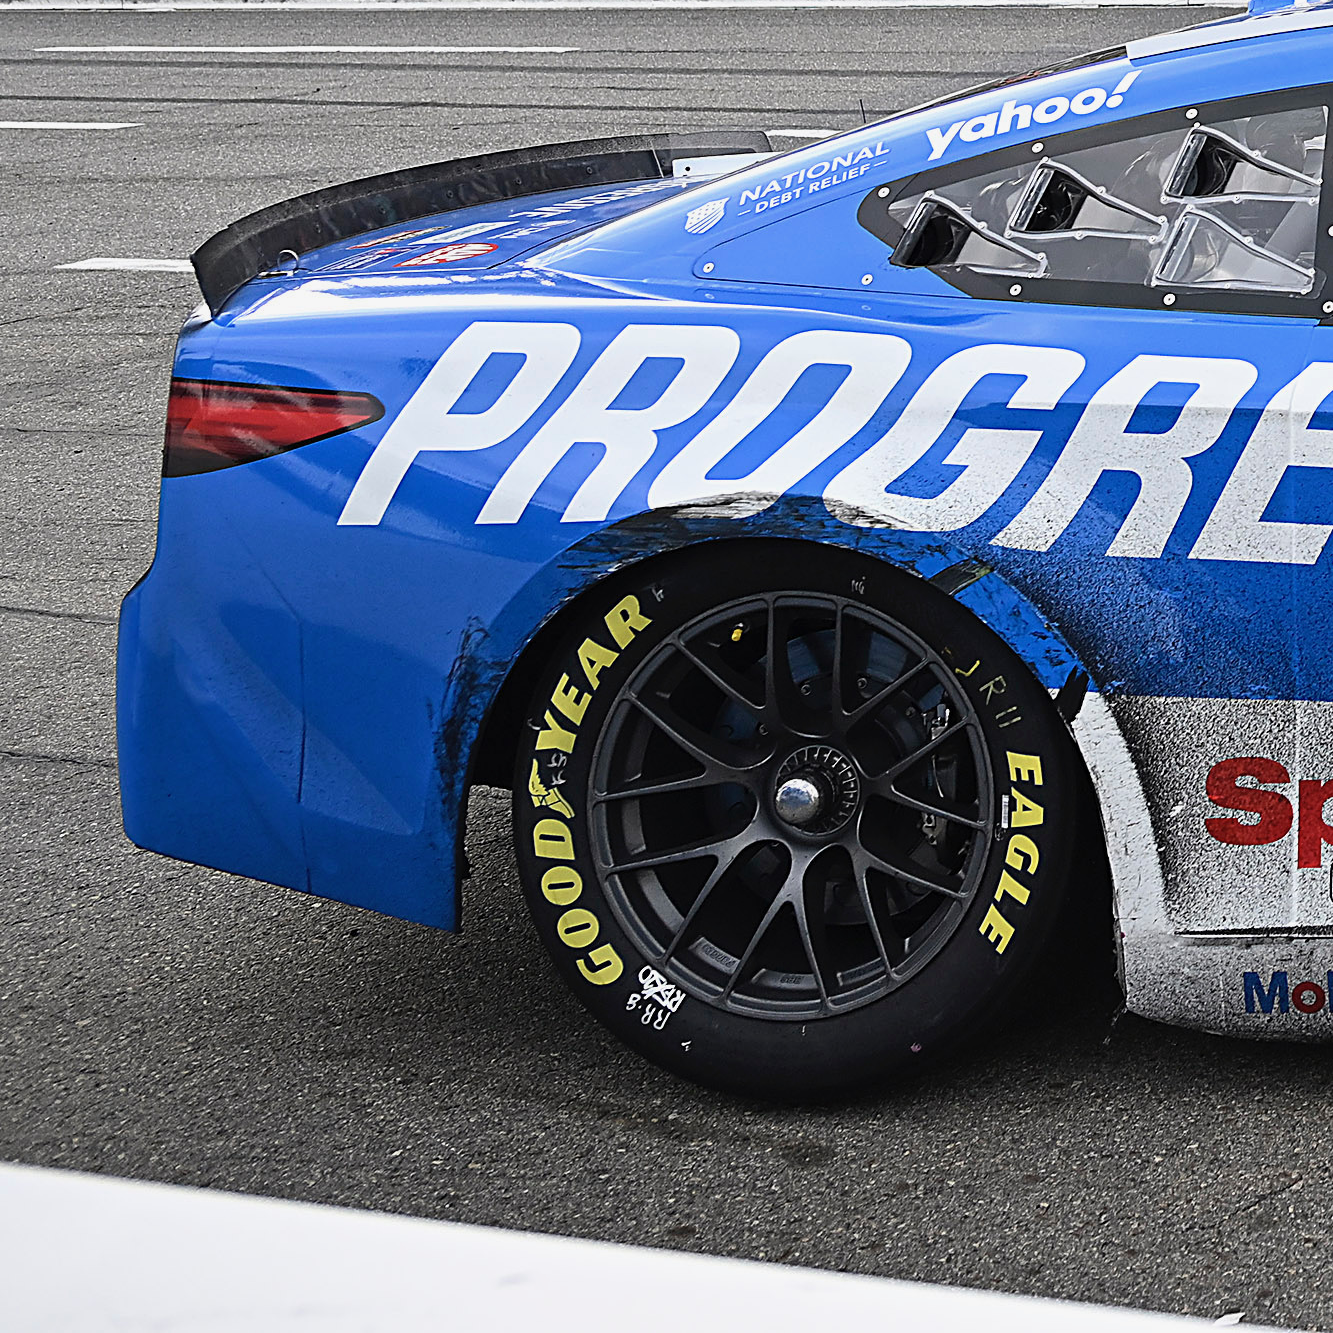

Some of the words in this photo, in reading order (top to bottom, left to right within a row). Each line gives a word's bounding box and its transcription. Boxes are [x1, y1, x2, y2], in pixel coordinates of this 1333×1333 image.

[925, 69, 1143, 161] yahoo!
[738, 141, 891, 207] NATIONAL
[754, 187, 807, 215] DEBT
[808, 162, 873, 195] RELIEF
[978, 749, 1045, 955] EAGLE
